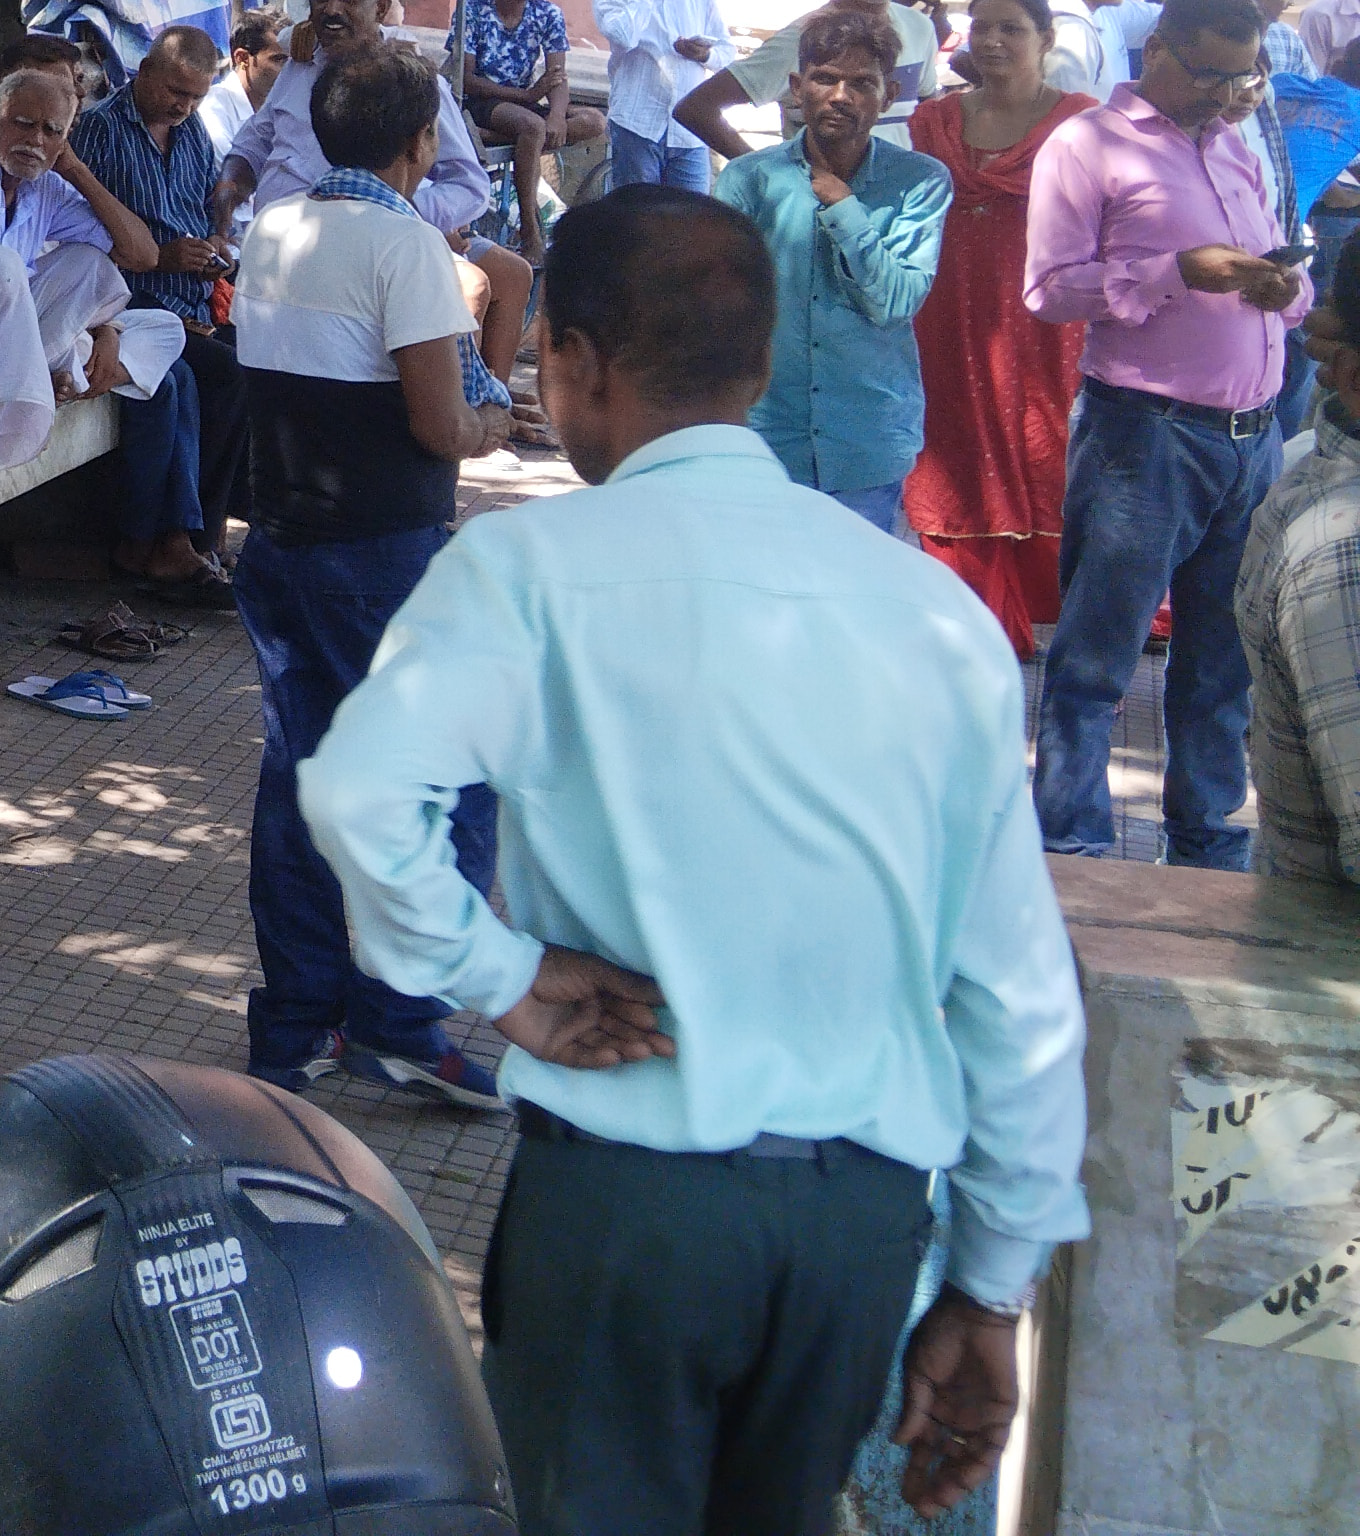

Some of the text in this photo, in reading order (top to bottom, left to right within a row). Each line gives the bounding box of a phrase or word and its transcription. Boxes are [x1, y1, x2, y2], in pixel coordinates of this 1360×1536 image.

[138, 1212, 215, 1242] NINJA ELITE
[136, 1237, 247, 1306] STUDDS
[191, 1326, 240, 1365] DOT
[196, 1444, 307, 1486] TWO WHEELER HELMET
[211, 1468, 307, 1515] 1300 g
